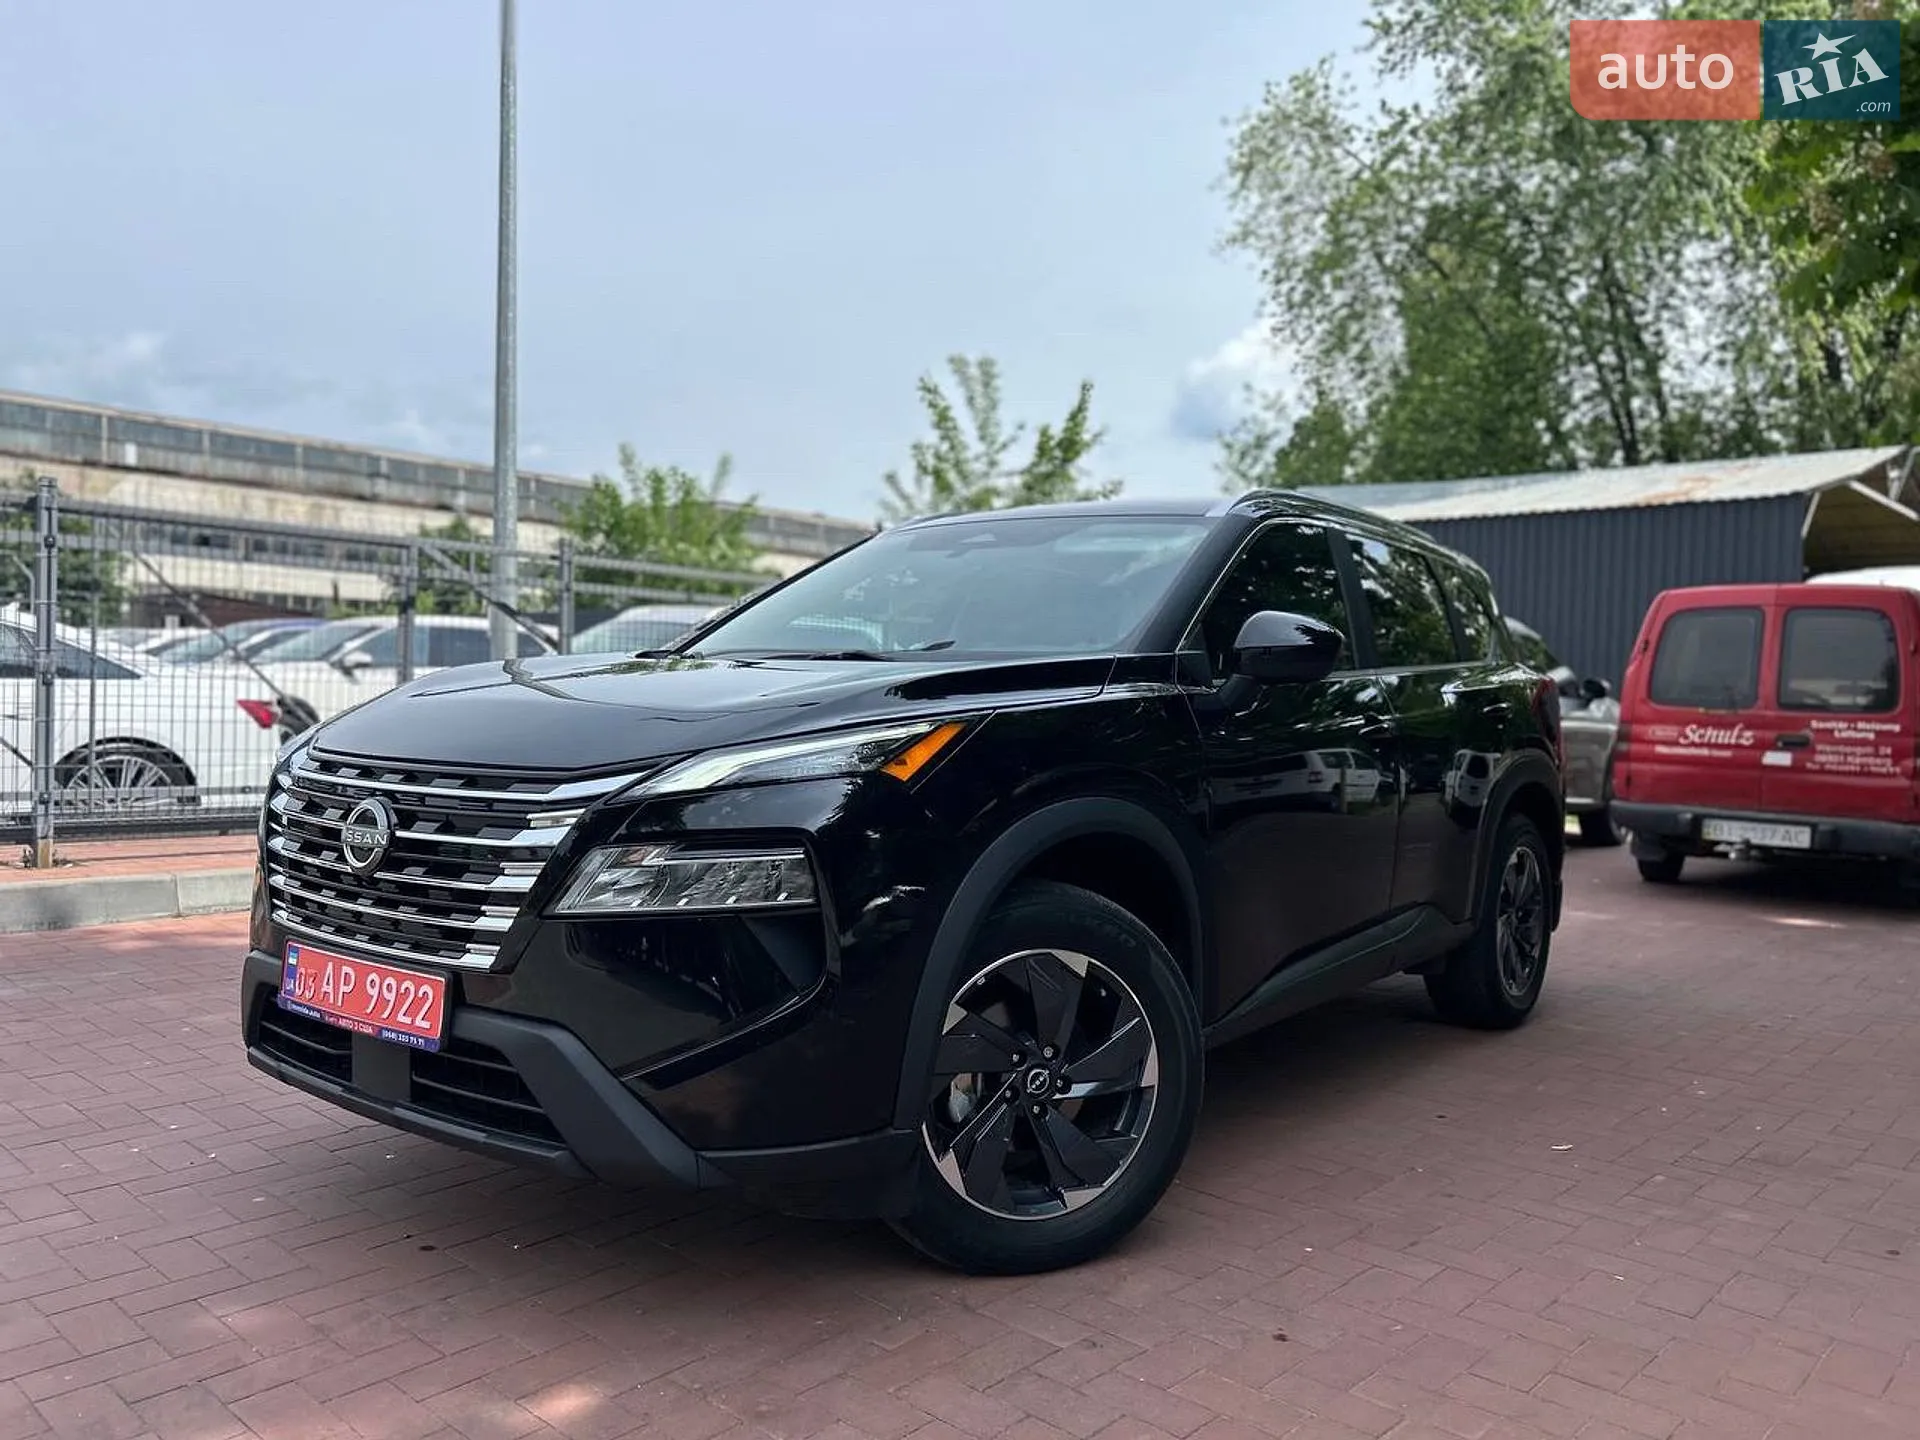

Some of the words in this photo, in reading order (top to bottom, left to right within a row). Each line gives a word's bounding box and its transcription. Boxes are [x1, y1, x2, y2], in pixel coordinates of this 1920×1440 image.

[1678, 722, 1755, 746] Schulz
[295, 967, 320, 1001] 03
[321, 961, 356, 1007] AP
[365, 972, 434, 1030] 9922
